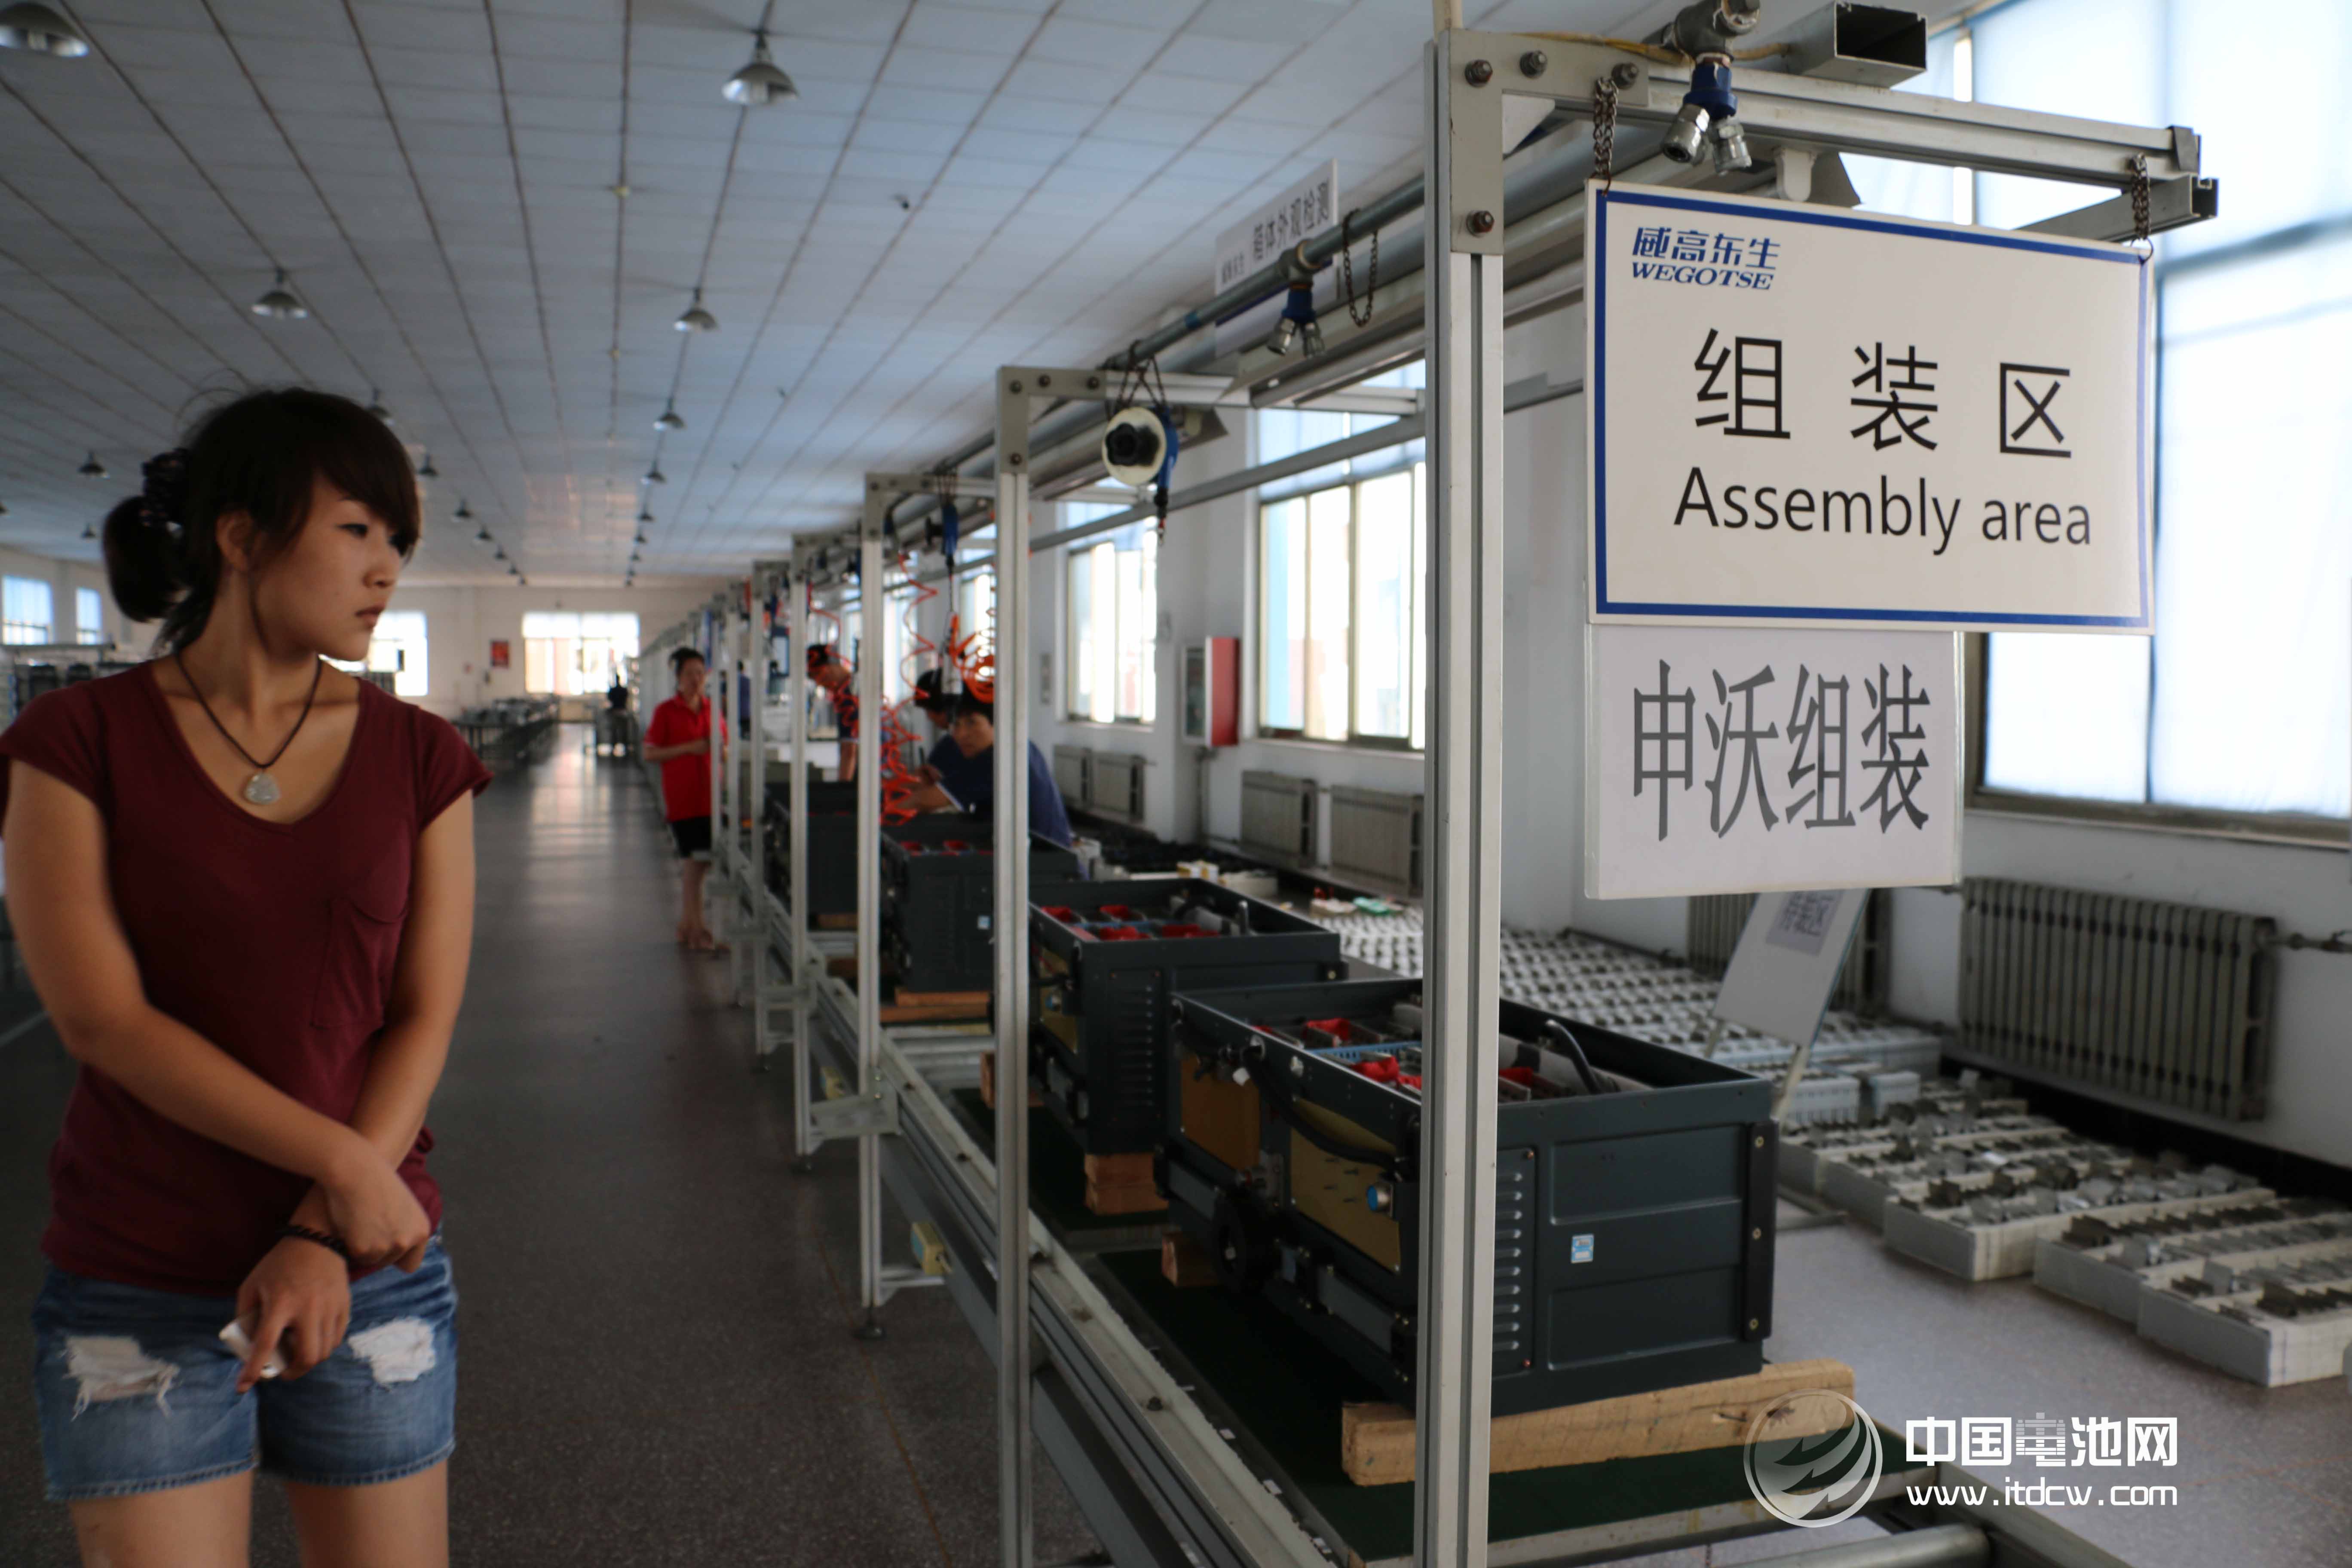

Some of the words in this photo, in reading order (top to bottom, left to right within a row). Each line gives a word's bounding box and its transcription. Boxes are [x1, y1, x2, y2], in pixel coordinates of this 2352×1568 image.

[1632, 227, 1780, 270] 威高东生
[1632, 262, 1774, 290] WEGOTSE
[1694, 328, 2071, 458] 组装区
[1673, 466, 1961, 556] Assembly
[1981, 499, 2091, 545] area
[1633, 658, 1931, 842] 申沃组装
